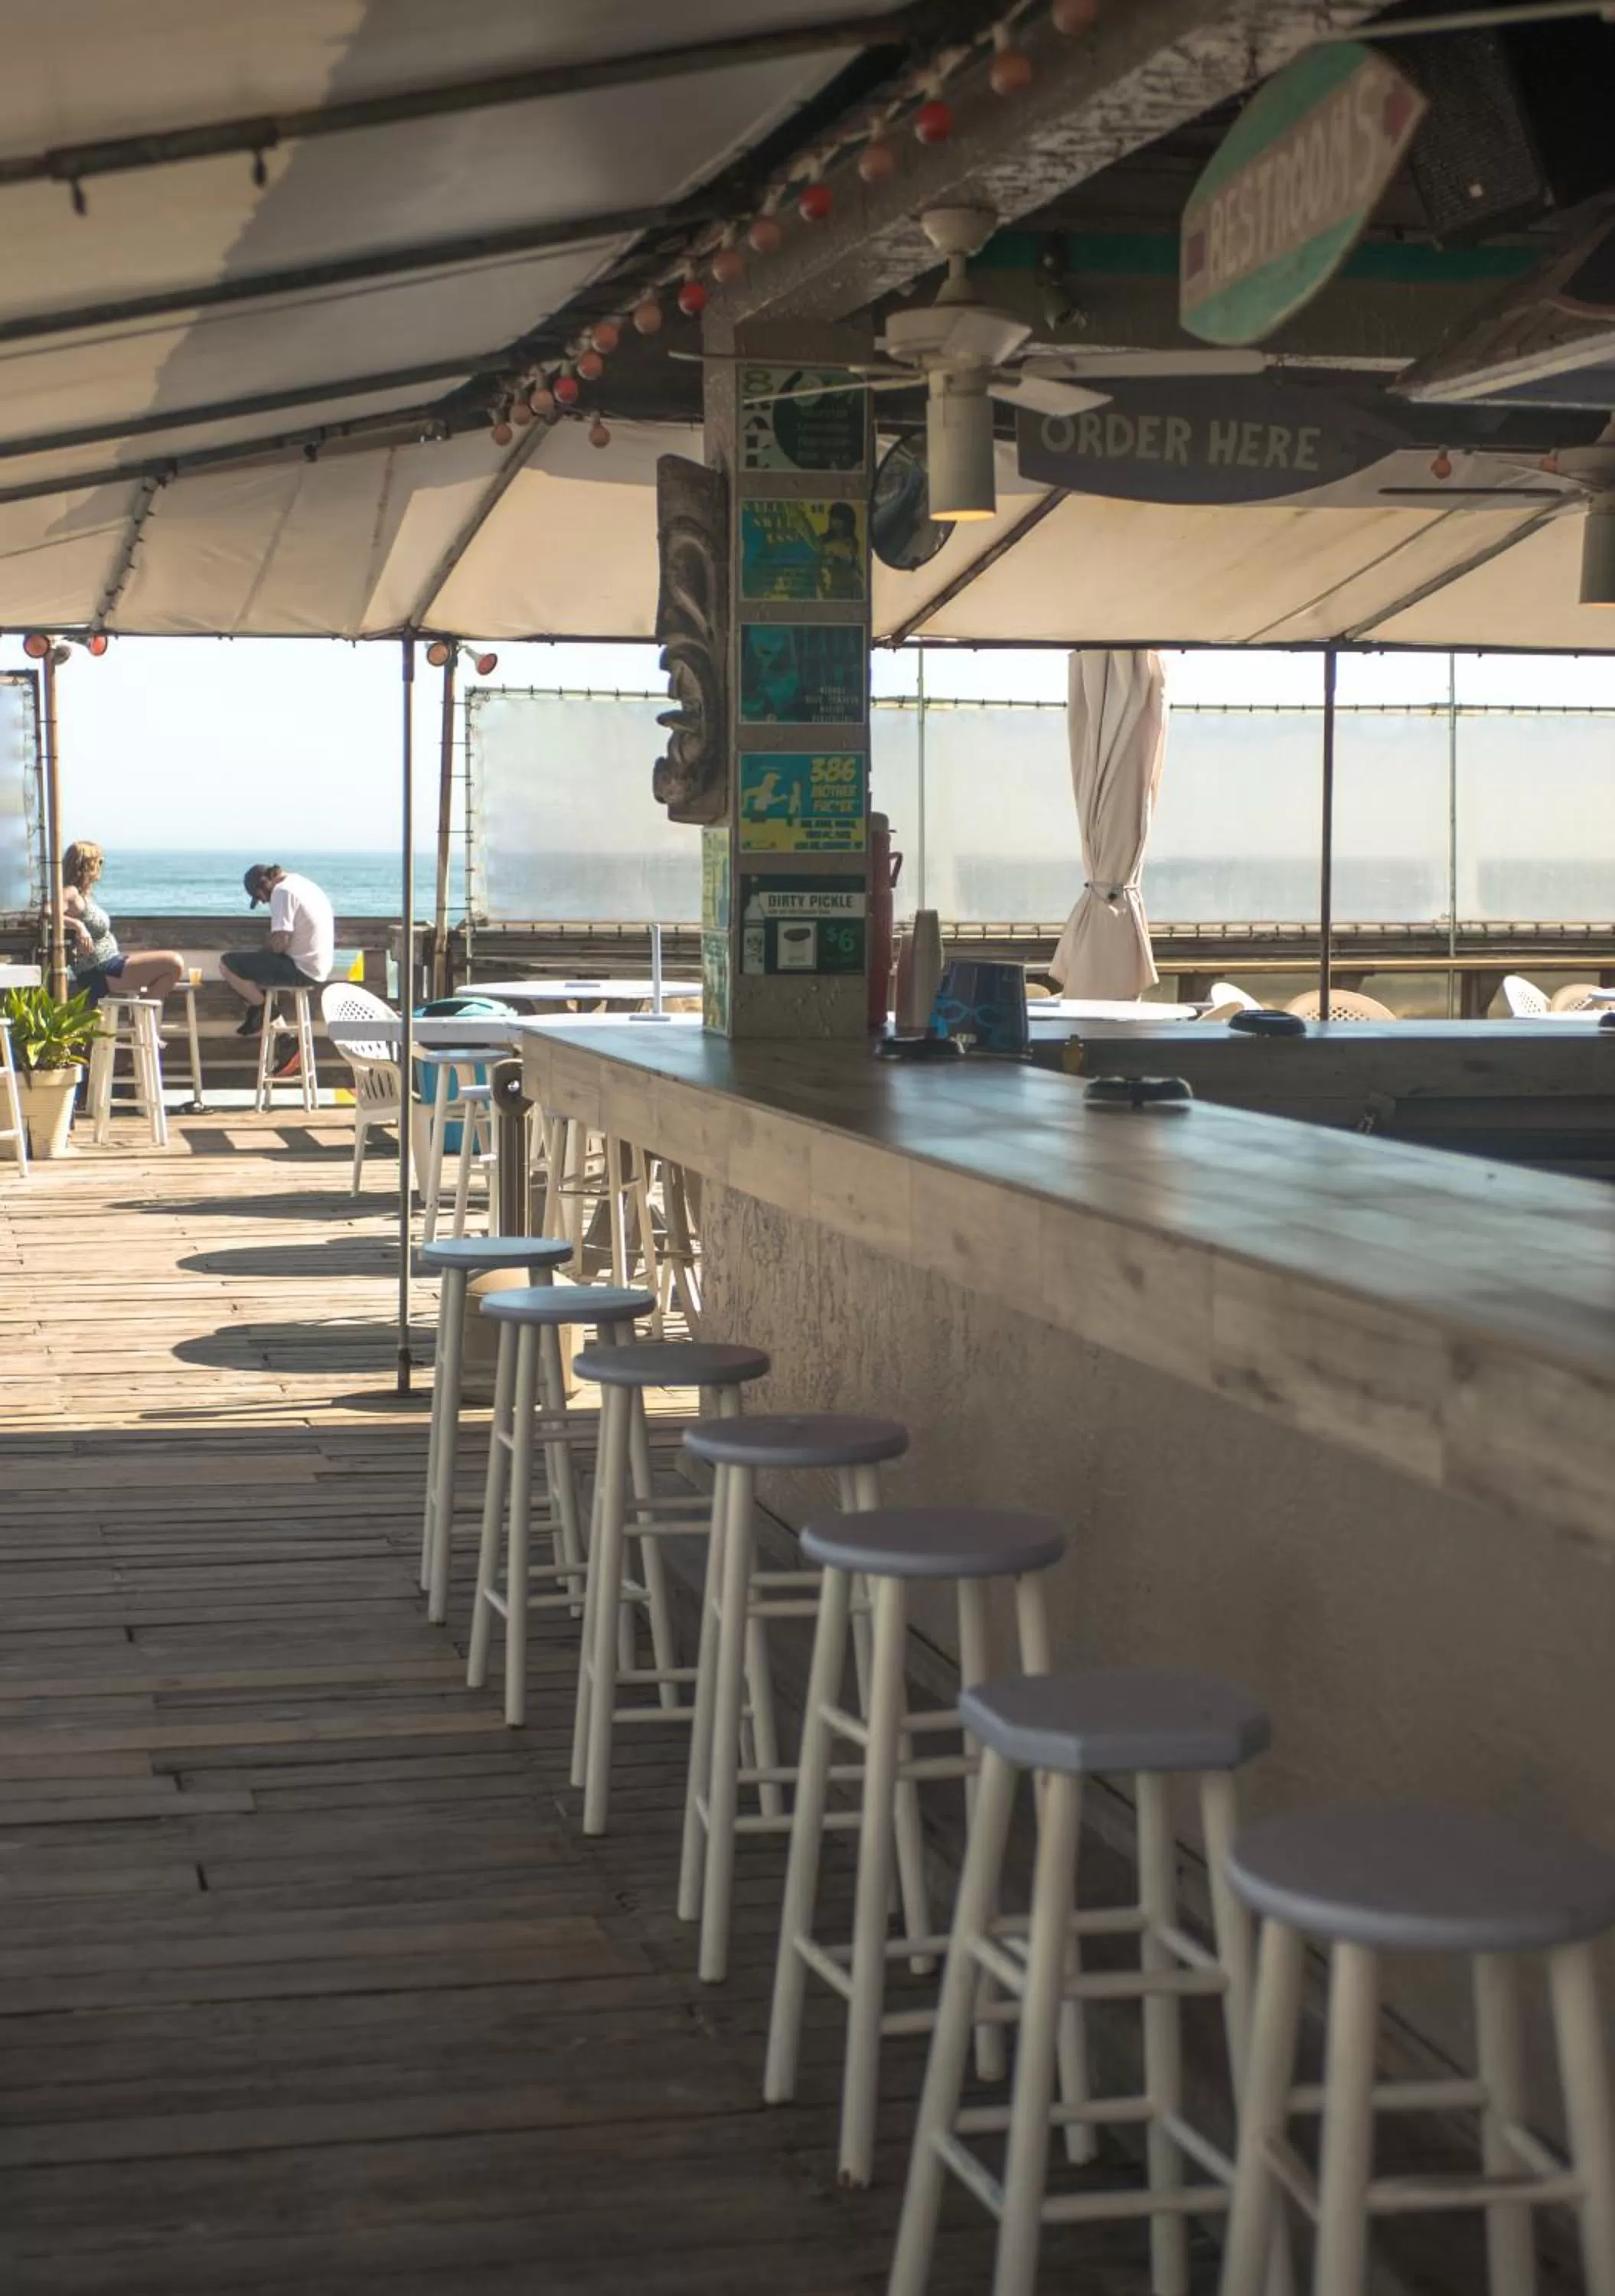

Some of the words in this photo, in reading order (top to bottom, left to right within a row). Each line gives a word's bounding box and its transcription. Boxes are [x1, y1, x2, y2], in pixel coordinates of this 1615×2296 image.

[1040, 413, 1192, 466] ORDER
[1207, 419, 1322, 471] HERE
[810, 756, 857, 783] 386
[768, 894, 806, 908] DIRTY
[809, 894, 854, 908] PICKLE
